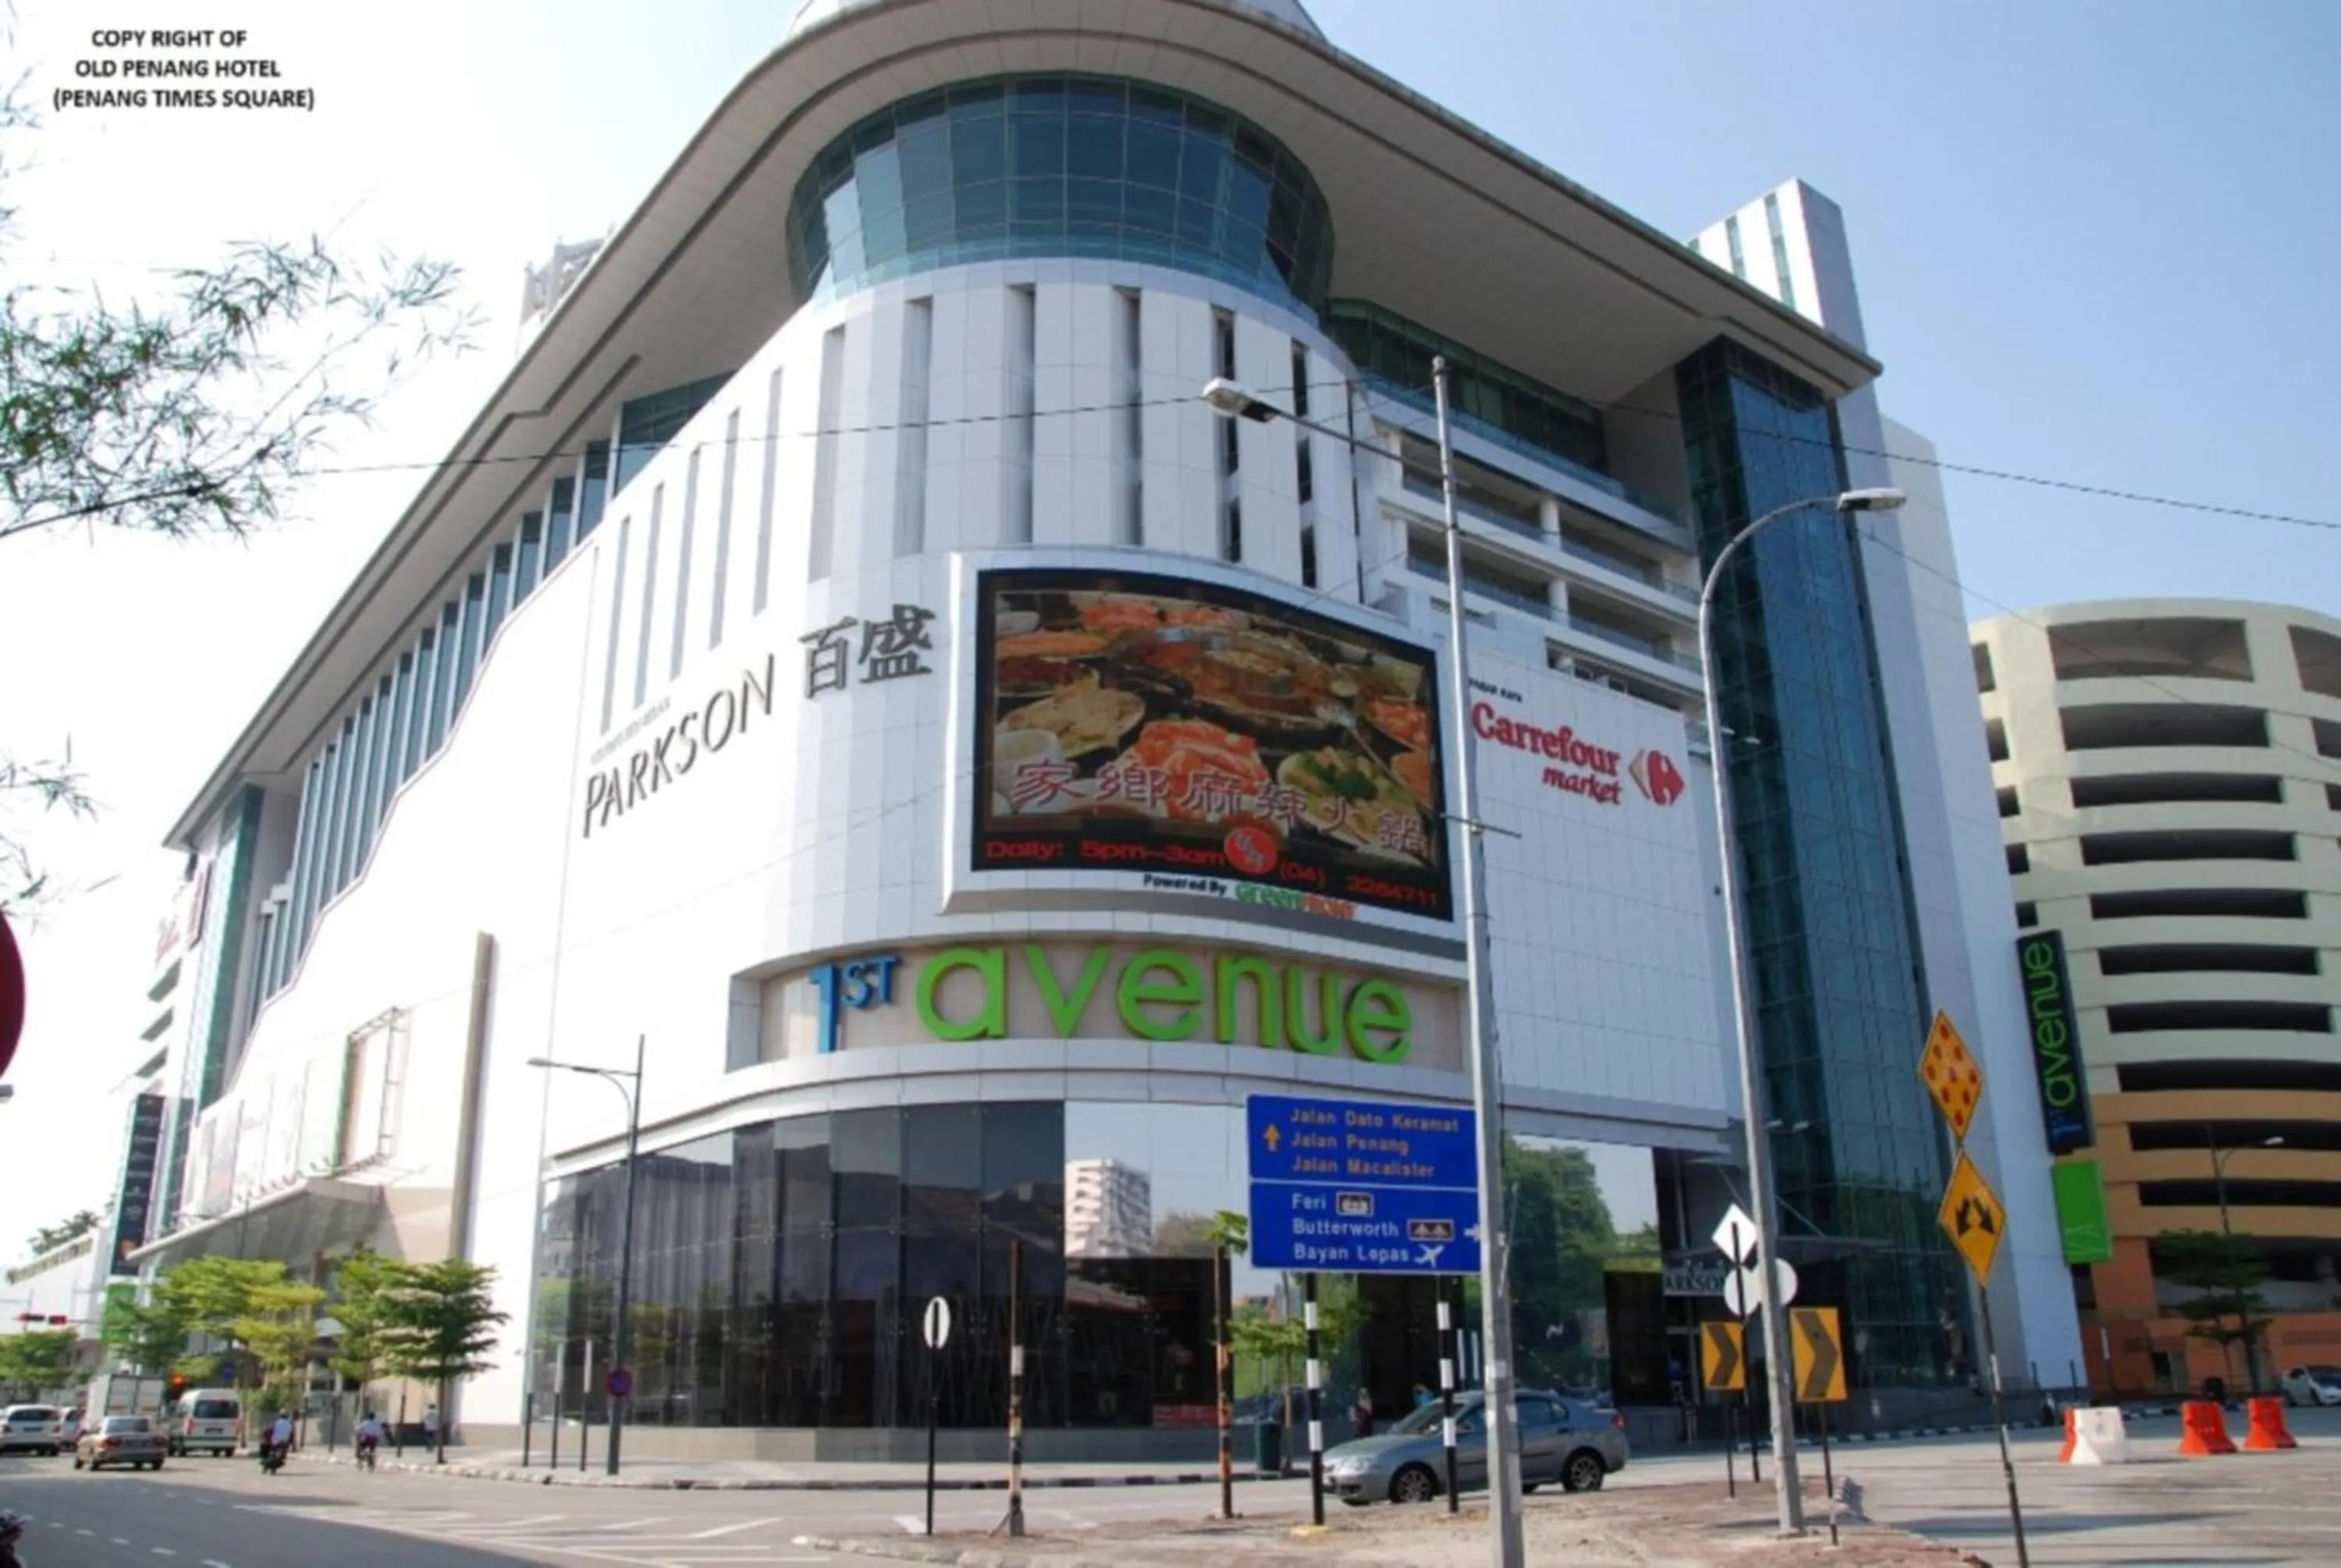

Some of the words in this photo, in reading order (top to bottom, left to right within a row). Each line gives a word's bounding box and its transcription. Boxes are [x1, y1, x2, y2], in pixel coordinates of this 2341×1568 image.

[798, 603, 936, 699] 百盛
[583, 653, 774, 838] PARKSON
[1472, 701, 1621, 777] Carrefour
[1543, 765, 1622, 805] market
[1143, 873, 1206, 892] Powered
[1210, 880, 1227, 896] By
[808, 955, 903, 1054] 1ST
[915, 942, 1414, 1062] avenue
[2024, 940, 2077, 1107] avenue
[1290, 1108, 1336, 1125] Jalan
[1345, 1110, 1383, 1128] Dato
[1392, 1113, 1458, 1132] Keramat
[1291, 1132, 1337, 1149] Jalan
[1347, 1133, 1409, 1155] Penang
[1292, 1156, 1338, 1173] Jalan
[1348, 1158, 1435, 1177] Macalister
[1291, 1193, 1326, 1209] Feri
[1292, 1218, 1399, 1237] Butterworth
[1294, 1243, 1349, 1263] Bayan
[1358, 1244, 1409, 1264] Lepas
